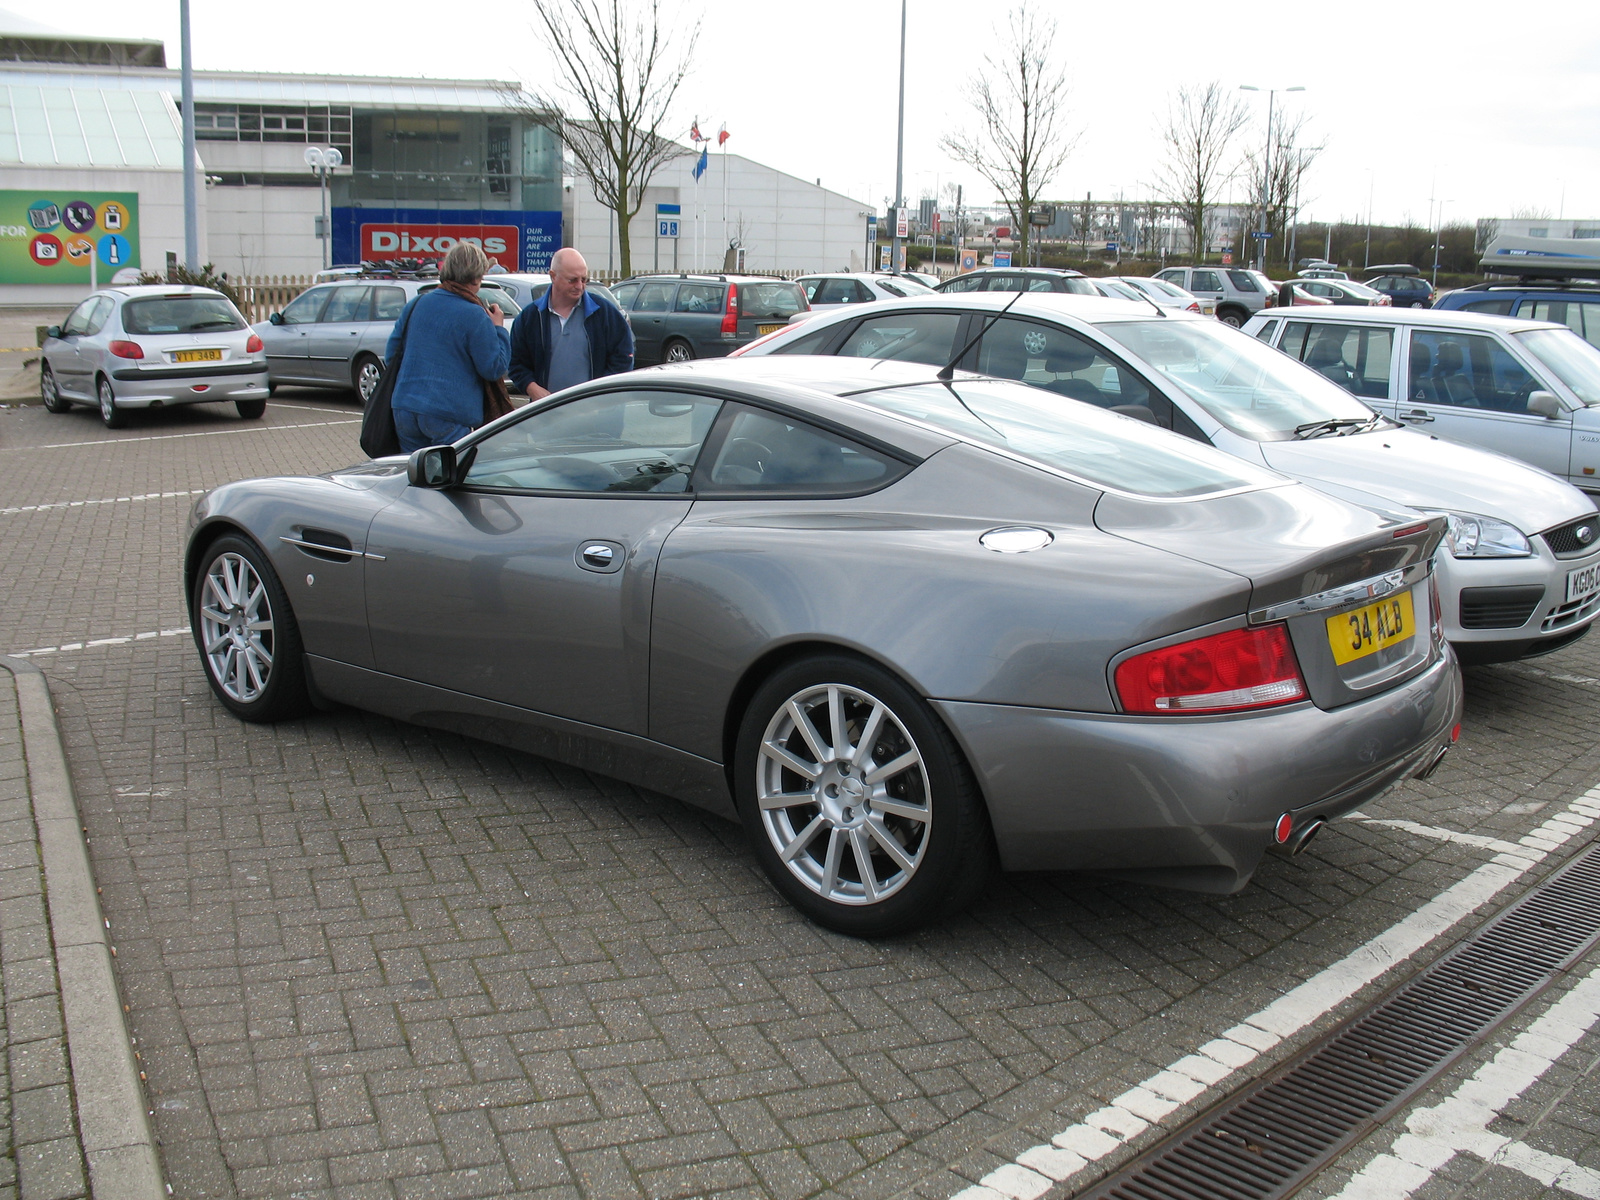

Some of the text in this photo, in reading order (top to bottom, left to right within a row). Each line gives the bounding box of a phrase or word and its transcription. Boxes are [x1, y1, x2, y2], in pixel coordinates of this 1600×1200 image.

[0, 225, 27, 237] FOR
[1349, 600, 1403, 650] 34 ALB
